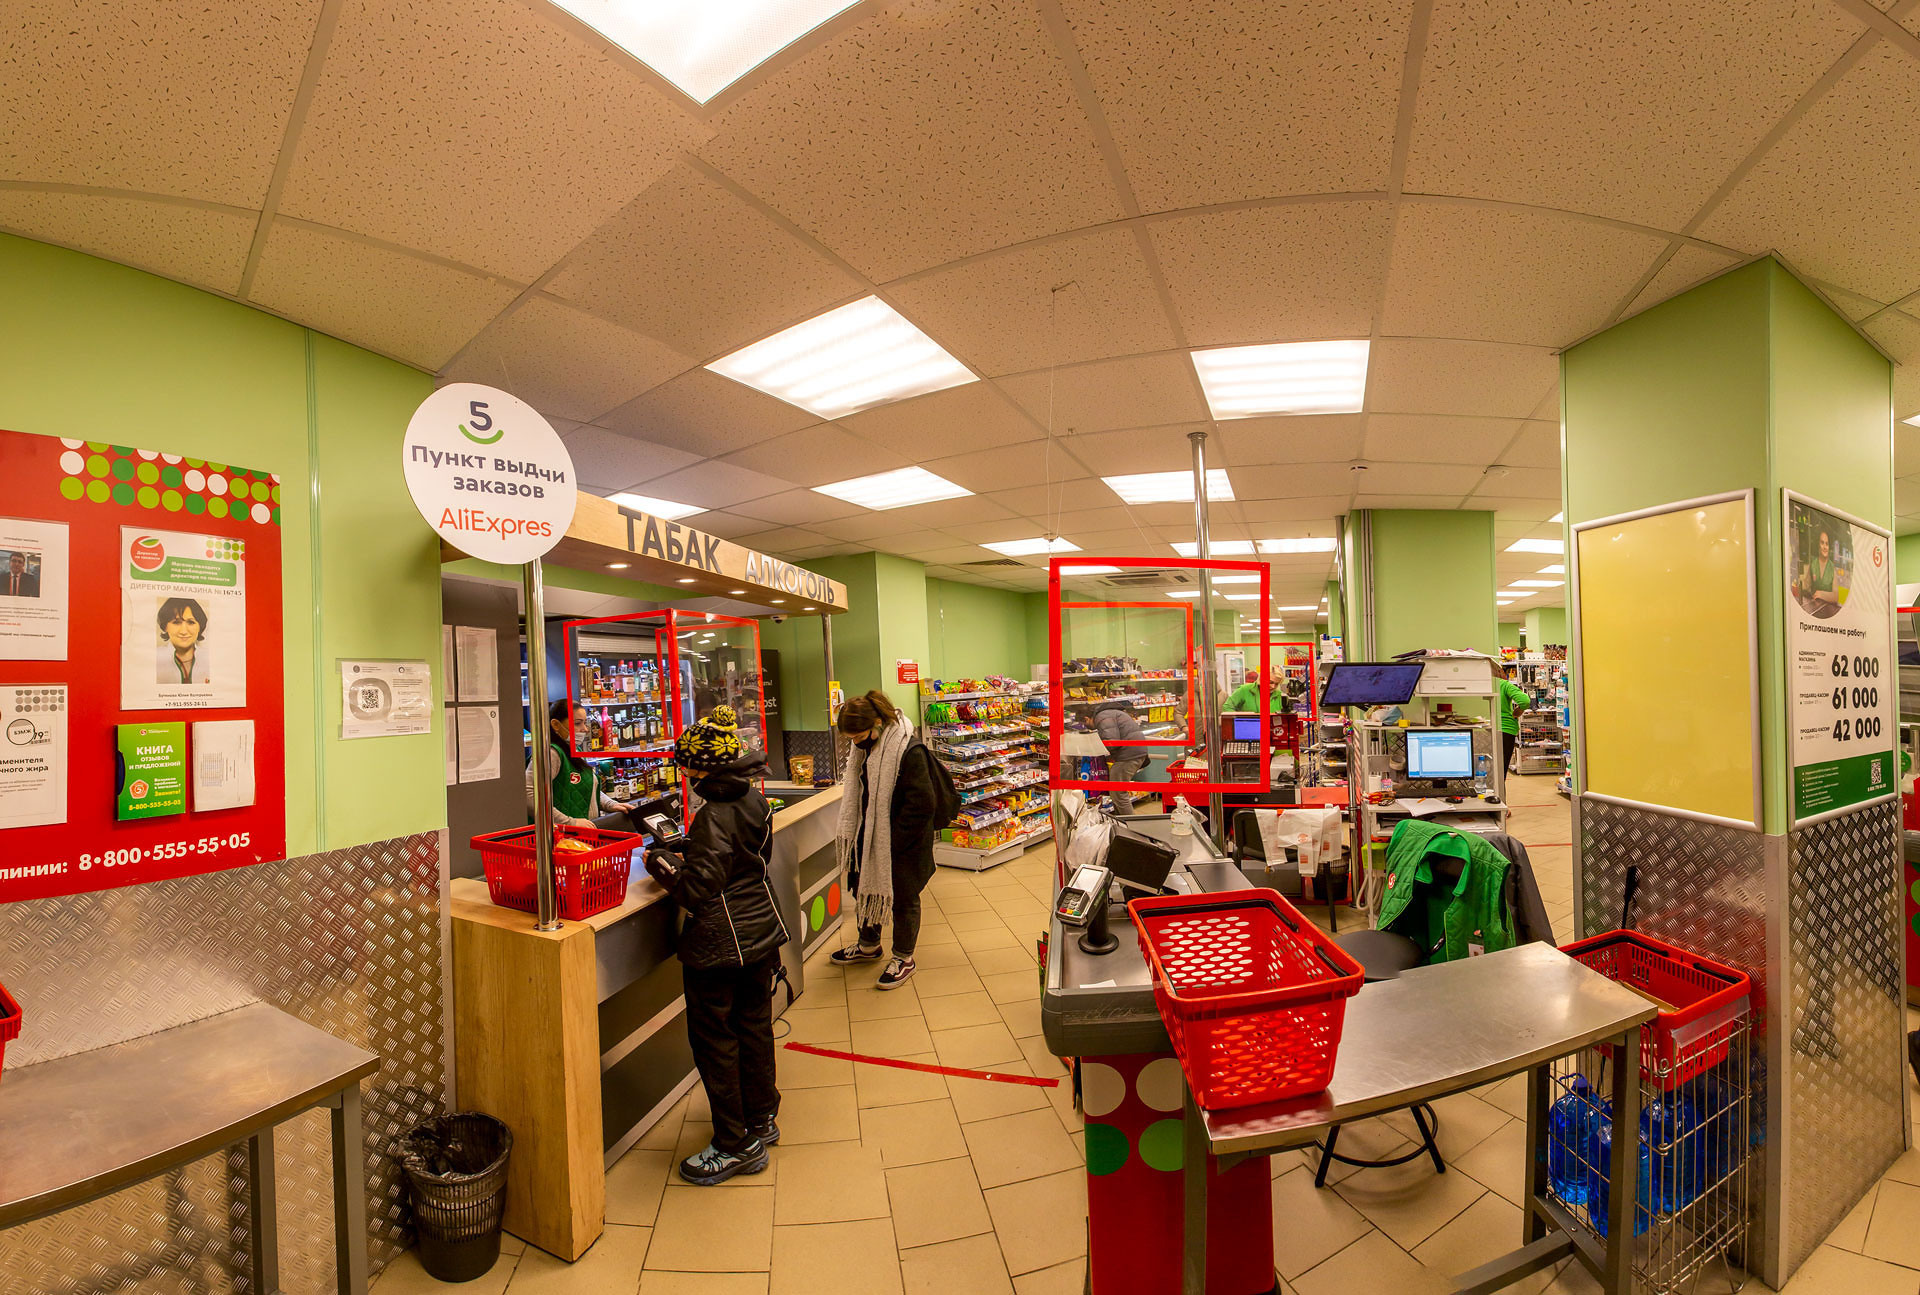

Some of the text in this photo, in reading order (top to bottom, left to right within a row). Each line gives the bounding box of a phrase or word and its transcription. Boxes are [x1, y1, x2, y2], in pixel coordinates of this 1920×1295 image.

[469, 400, 493, 431] 5
[411, 445, 565, 484] Пункт выдчи
[453, 476, 545, 499] заказов
[438, 508, 552, 540] AliExpres
[617, 504, 723, 575] ТАБАК
[130, 582, 172, 592] ДИРЕКТОР
[173, 584, 213, 594] МАГАЗИНА
[745, 550, 835, 604] АЛКОГОЛЬ
[1800, 622, 1838, 634] Приглашаем
[1832, 654, 1848, 677] 62
[1854, 656, 1879, 678] 000
[1832, 687, 1847, 710] 61
[1852, 687, 1878, 708] 000
[1832, 719, 1850, 742] 42
[1855, 716, 1880, 739] 000
[136, 744, 174, 755] КНИГА
[134, 760, 181, 770] ПРЕДЛОЖЕНИЙ
[128, 800, 181, 811] 8-800-555-55-05
[0, 861, 68, 880] линии:
